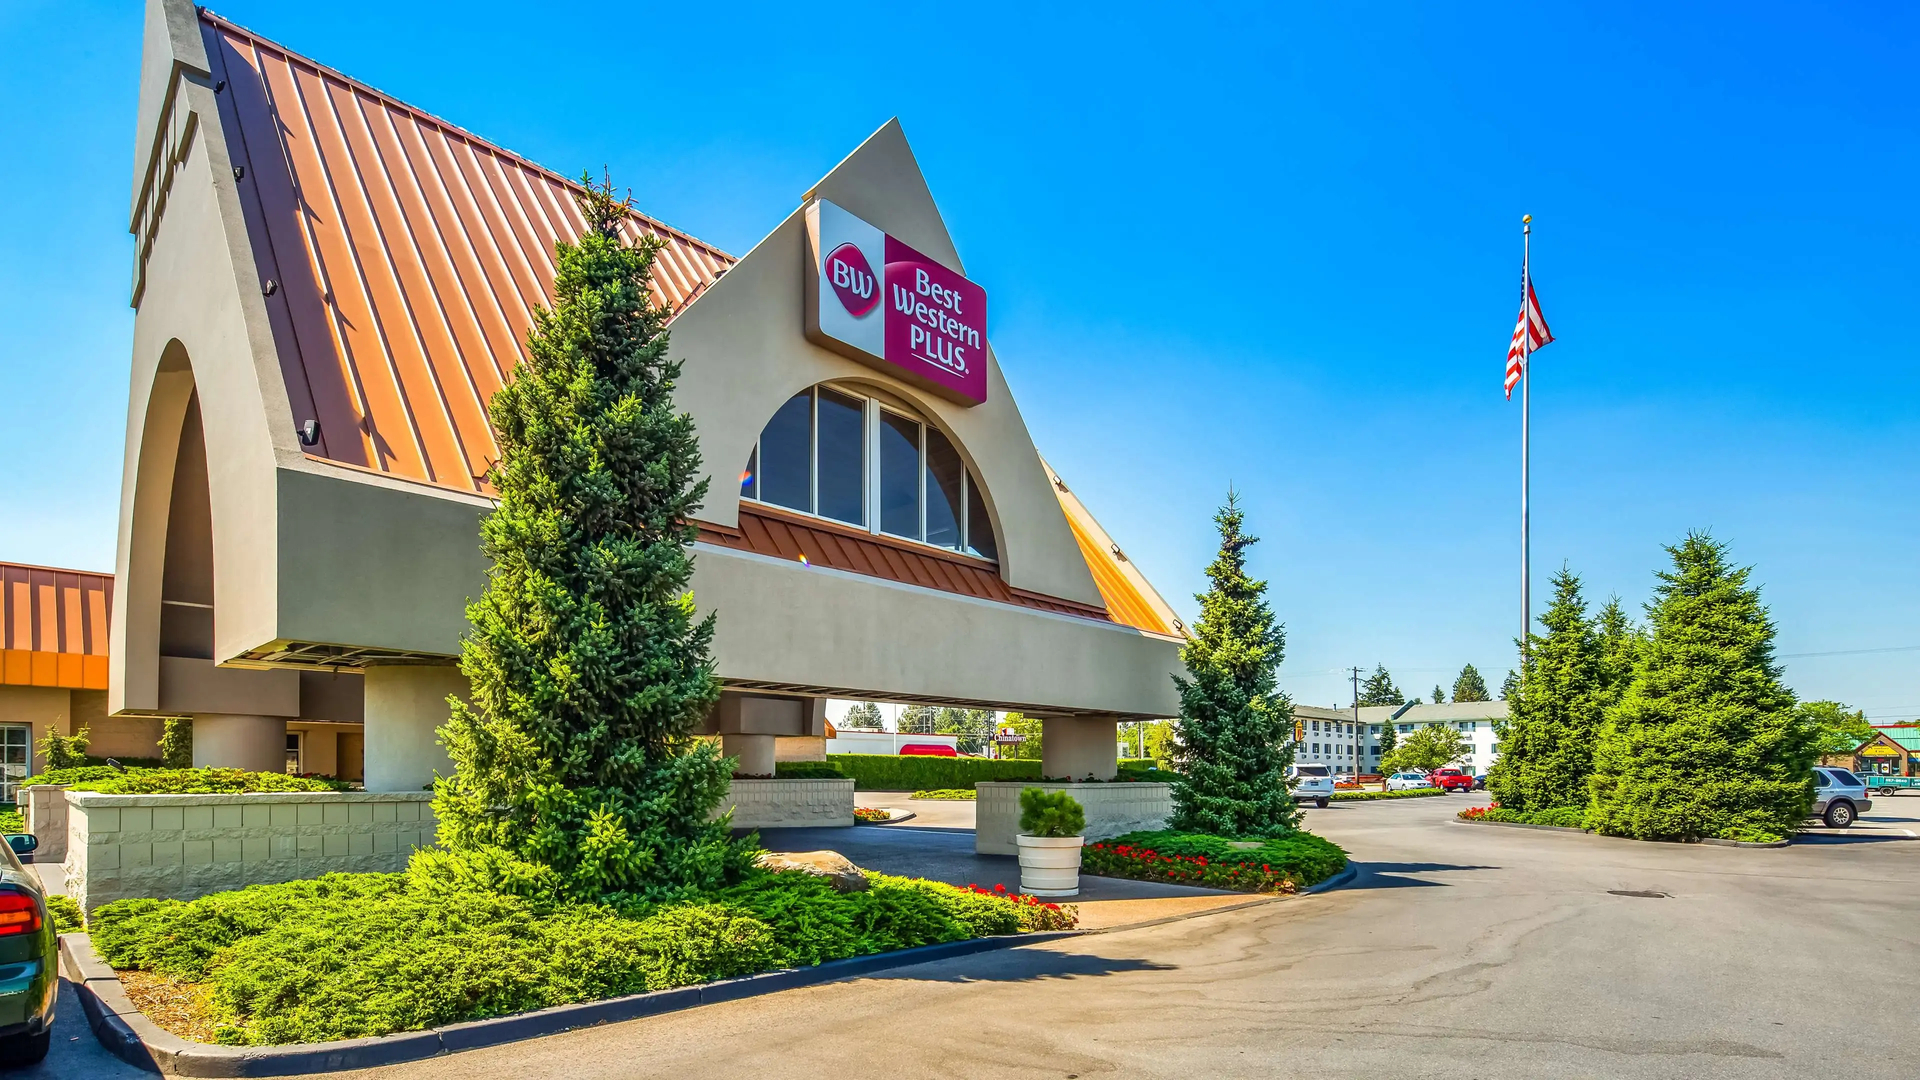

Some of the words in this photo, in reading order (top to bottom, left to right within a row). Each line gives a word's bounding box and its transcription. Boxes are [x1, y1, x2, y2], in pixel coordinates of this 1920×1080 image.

[833, 258, 873, 299] BW
[916, 268, 962, 315] Best
[893, 283, 981, 349] Western
[994, 733, 1027, 742] Chinatown
